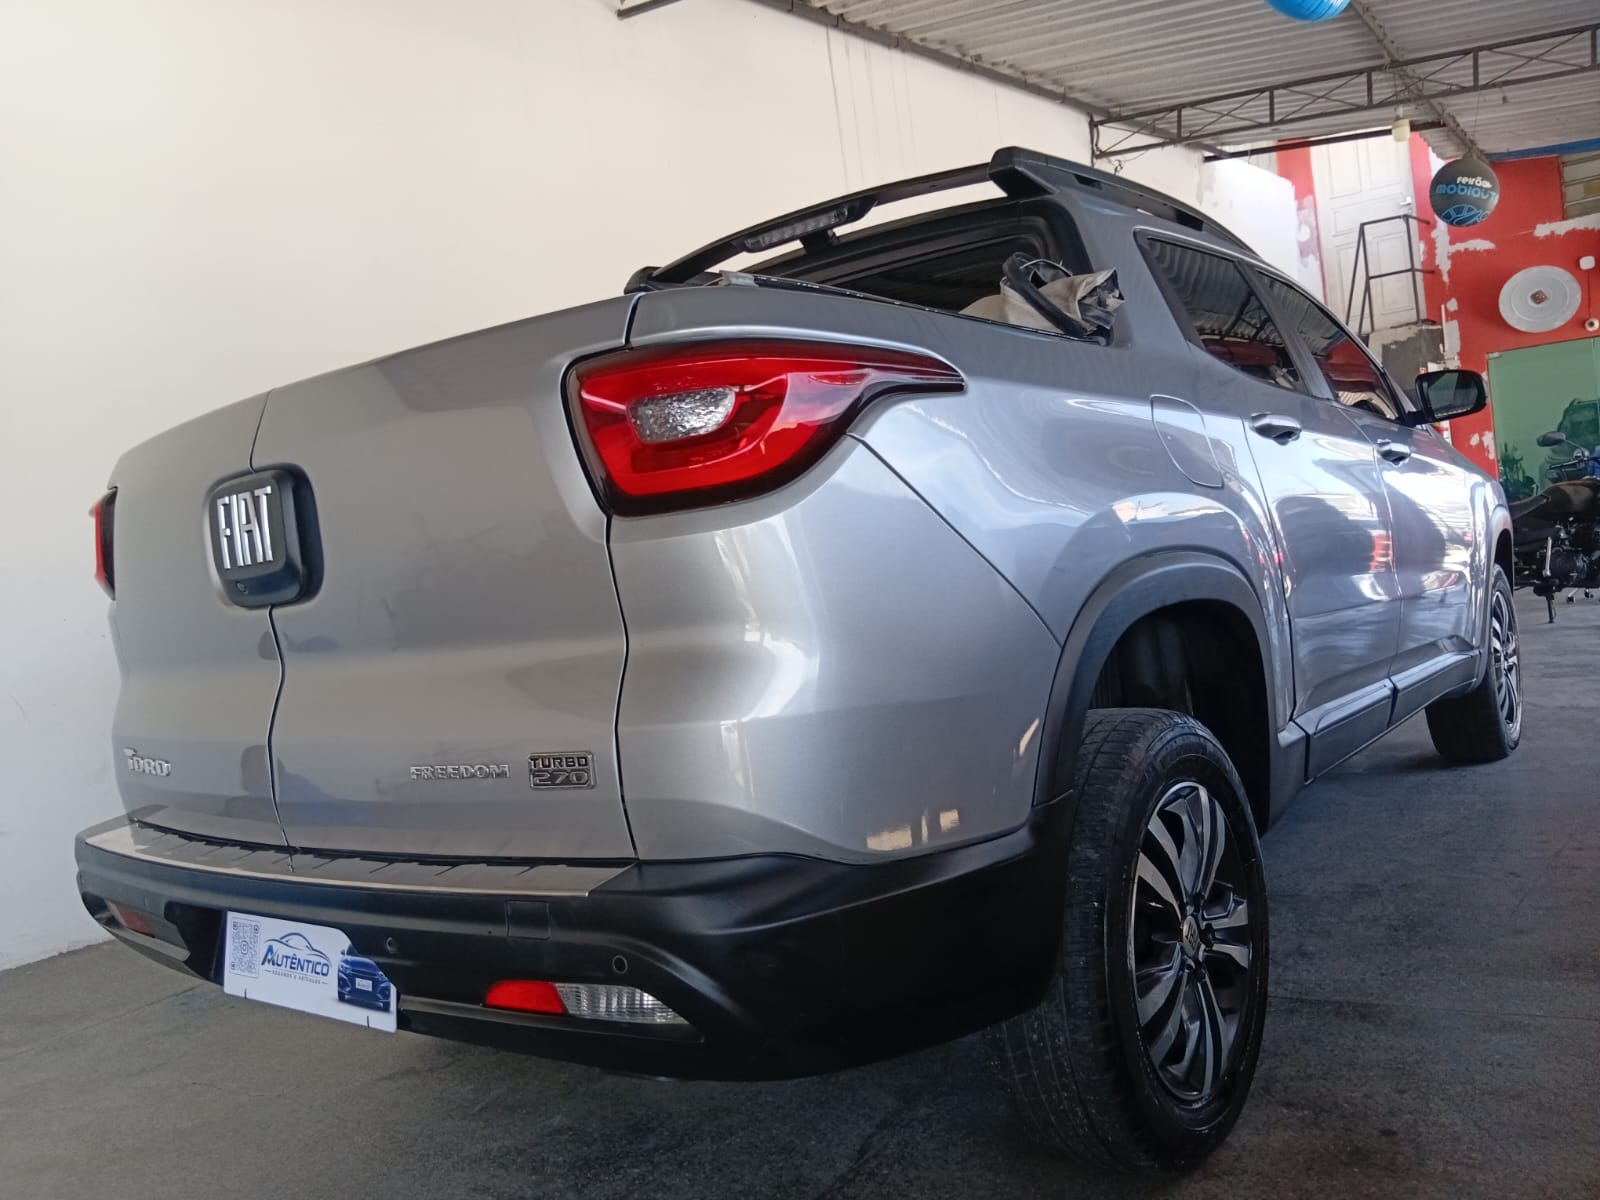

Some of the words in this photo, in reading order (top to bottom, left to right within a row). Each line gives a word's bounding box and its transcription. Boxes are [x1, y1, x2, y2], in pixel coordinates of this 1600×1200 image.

[217, 486, 273, 569] FIAT
[123, 748, 171, 776] TORO
[409, 764, 510, 780] FREEDOM
[530, 756, 588, 769] TURBO
[533, 771, 588, 784] 270
[261, 944, 330, 977] AUTÊNTICO
